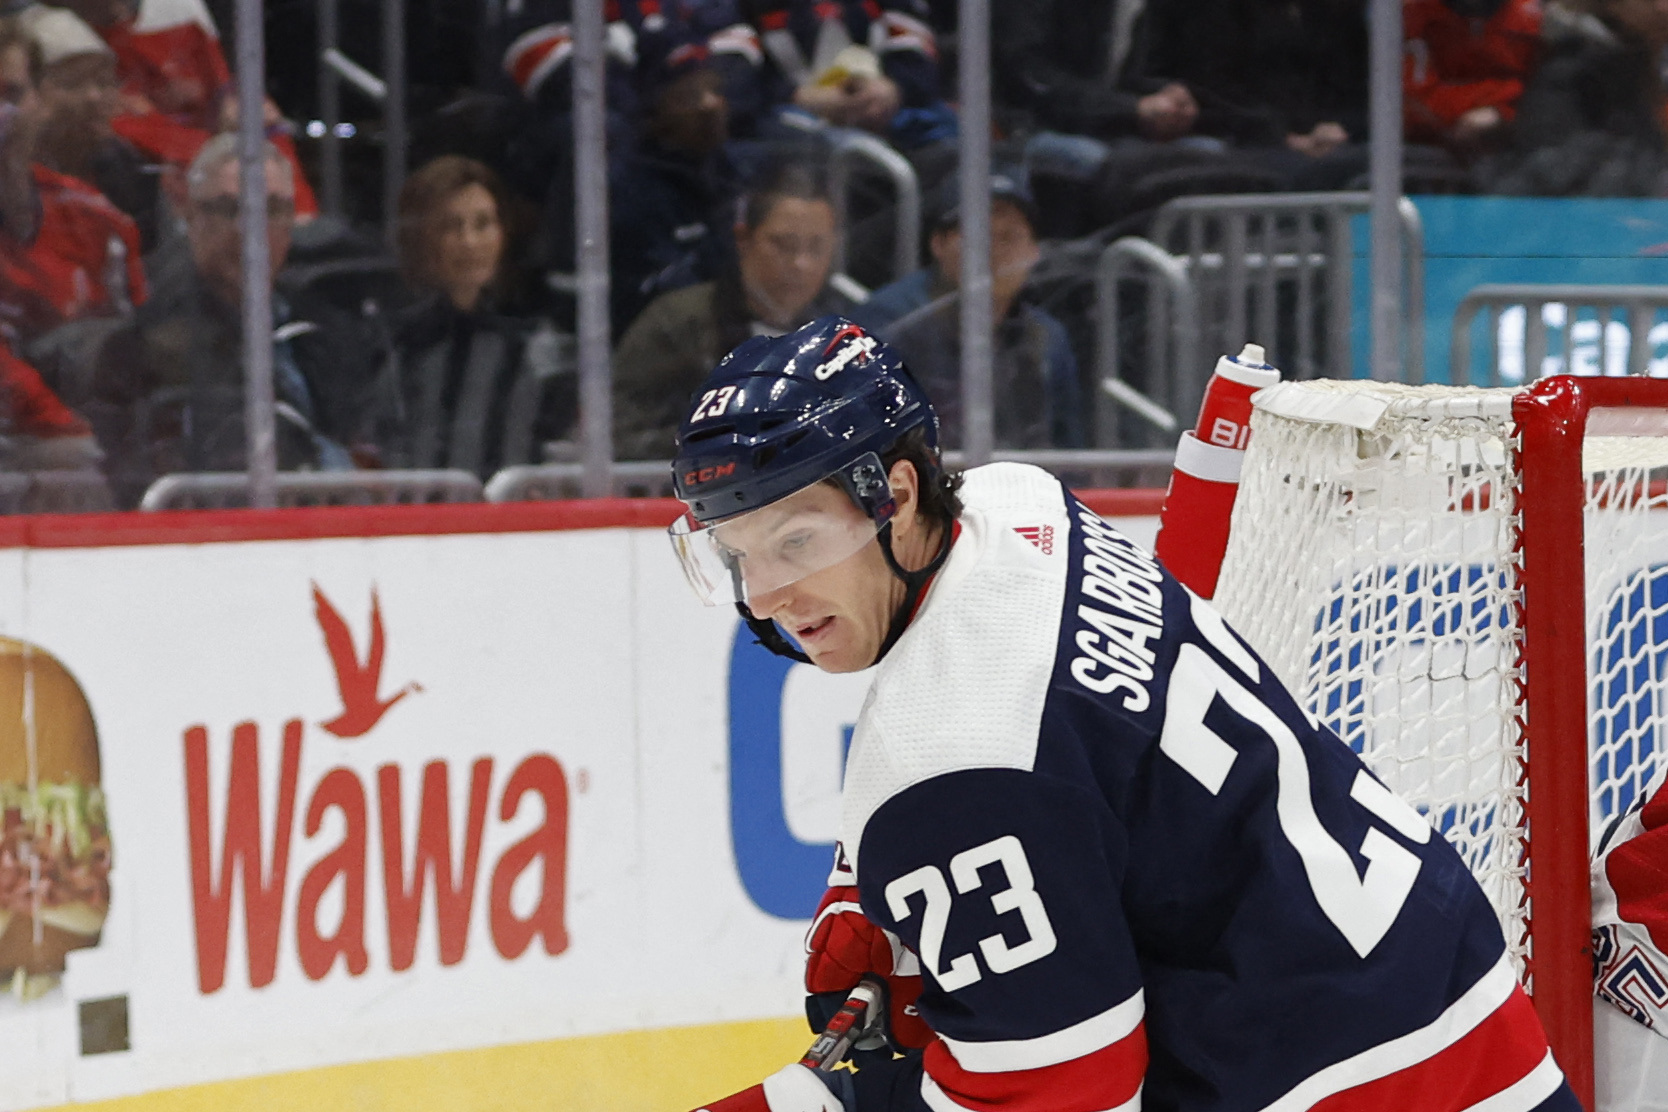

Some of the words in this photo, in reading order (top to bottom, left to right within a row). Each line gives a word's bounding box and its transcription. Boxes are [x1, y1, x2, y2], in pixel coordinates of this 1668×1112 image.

[684, 462, 736, 485] CCM
[690, 385, 738, 424] 23
[1071, 500, 1164, 712] SGARBOSS
[183, 718, 570, 995] Wawa
[885, 835, 1058, 993] 23
